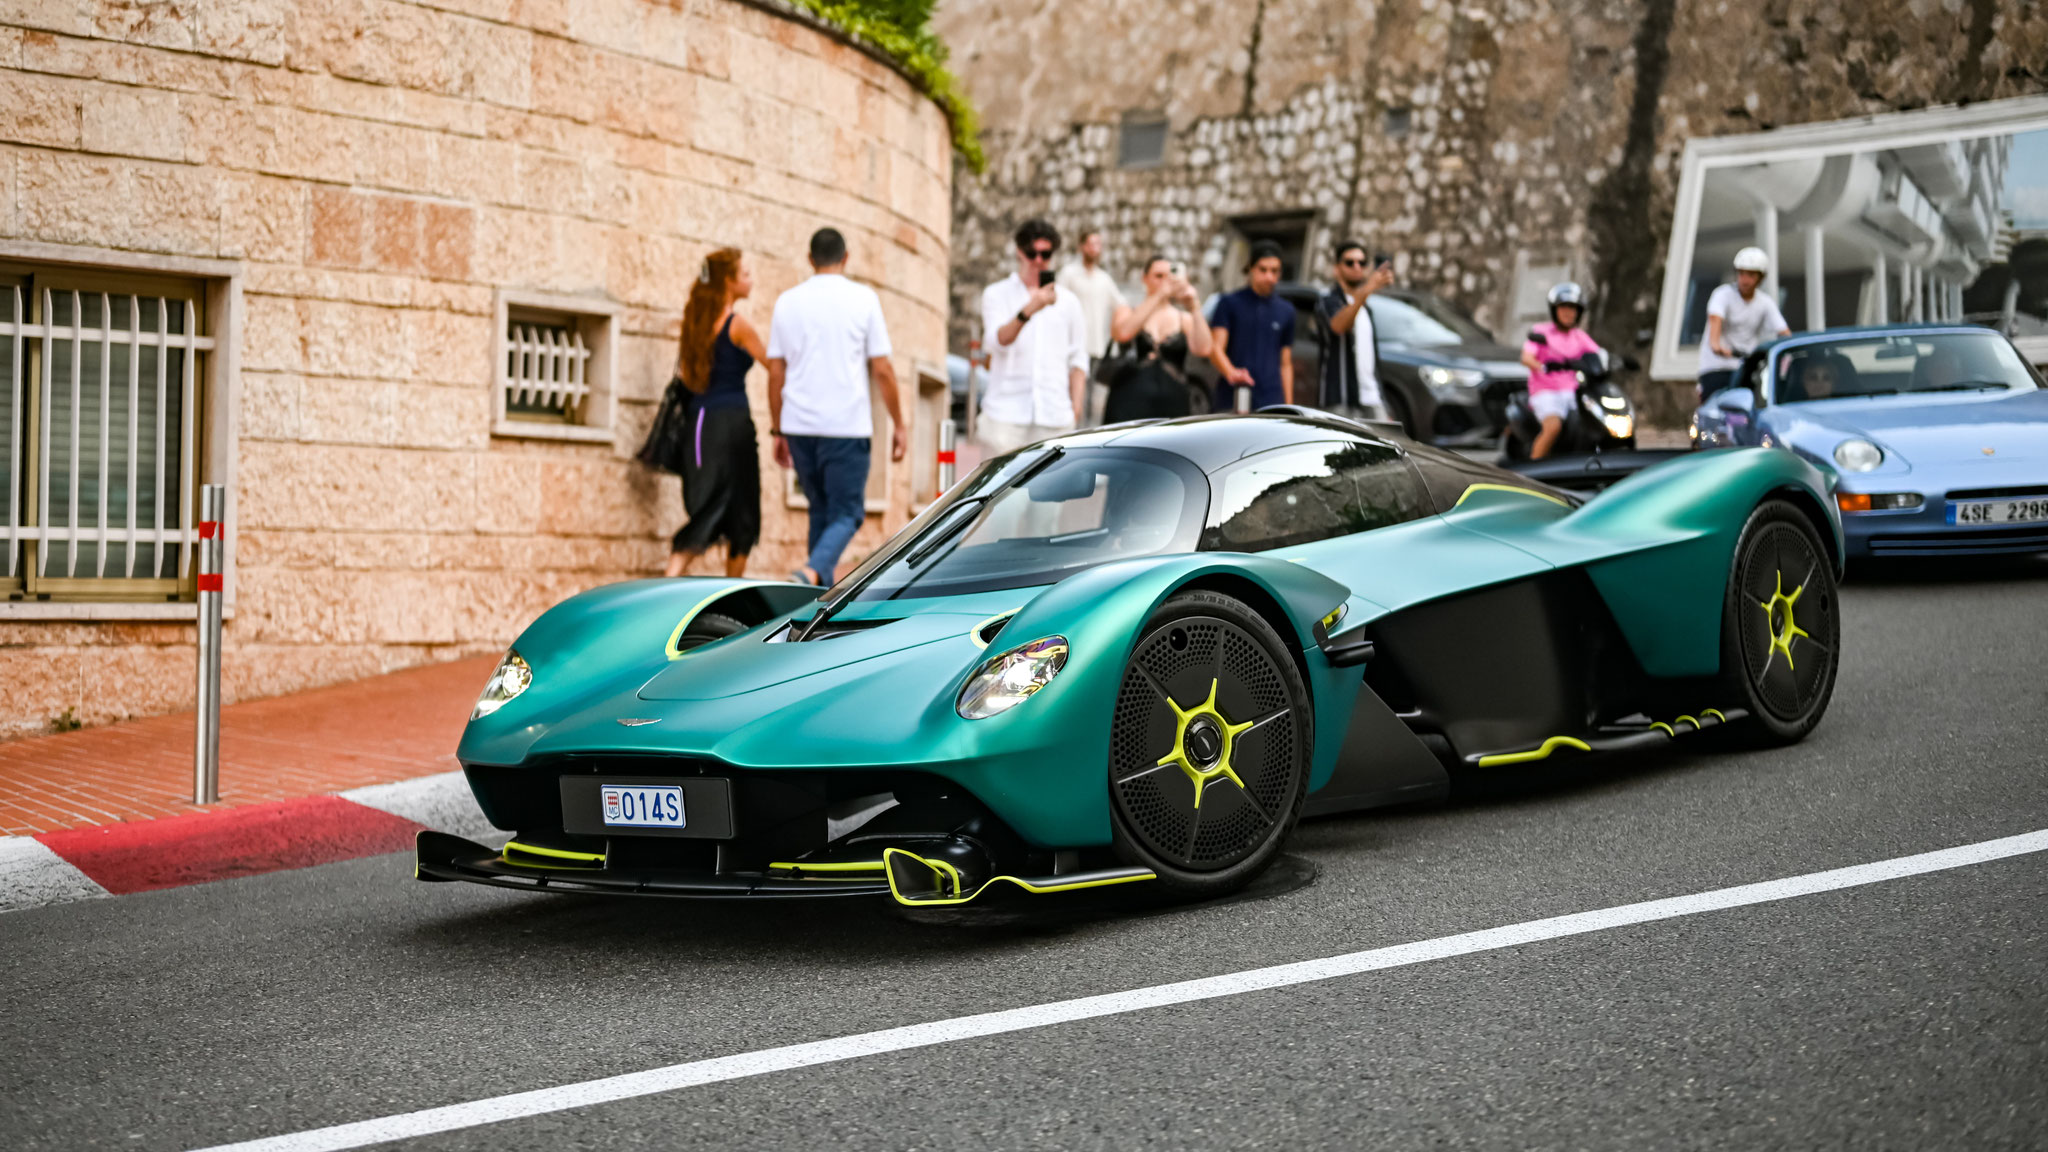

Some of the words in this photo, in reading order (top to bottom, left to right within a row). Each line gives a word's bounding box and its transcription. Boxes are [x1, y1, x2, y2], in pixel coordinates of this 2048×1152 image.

[1961, 504, 1993, 522] 4SE
[2007, 500, 2048, 521] 2299
[608, 806, 618, 816] MC
[622, 792, 679, 822] 014S
